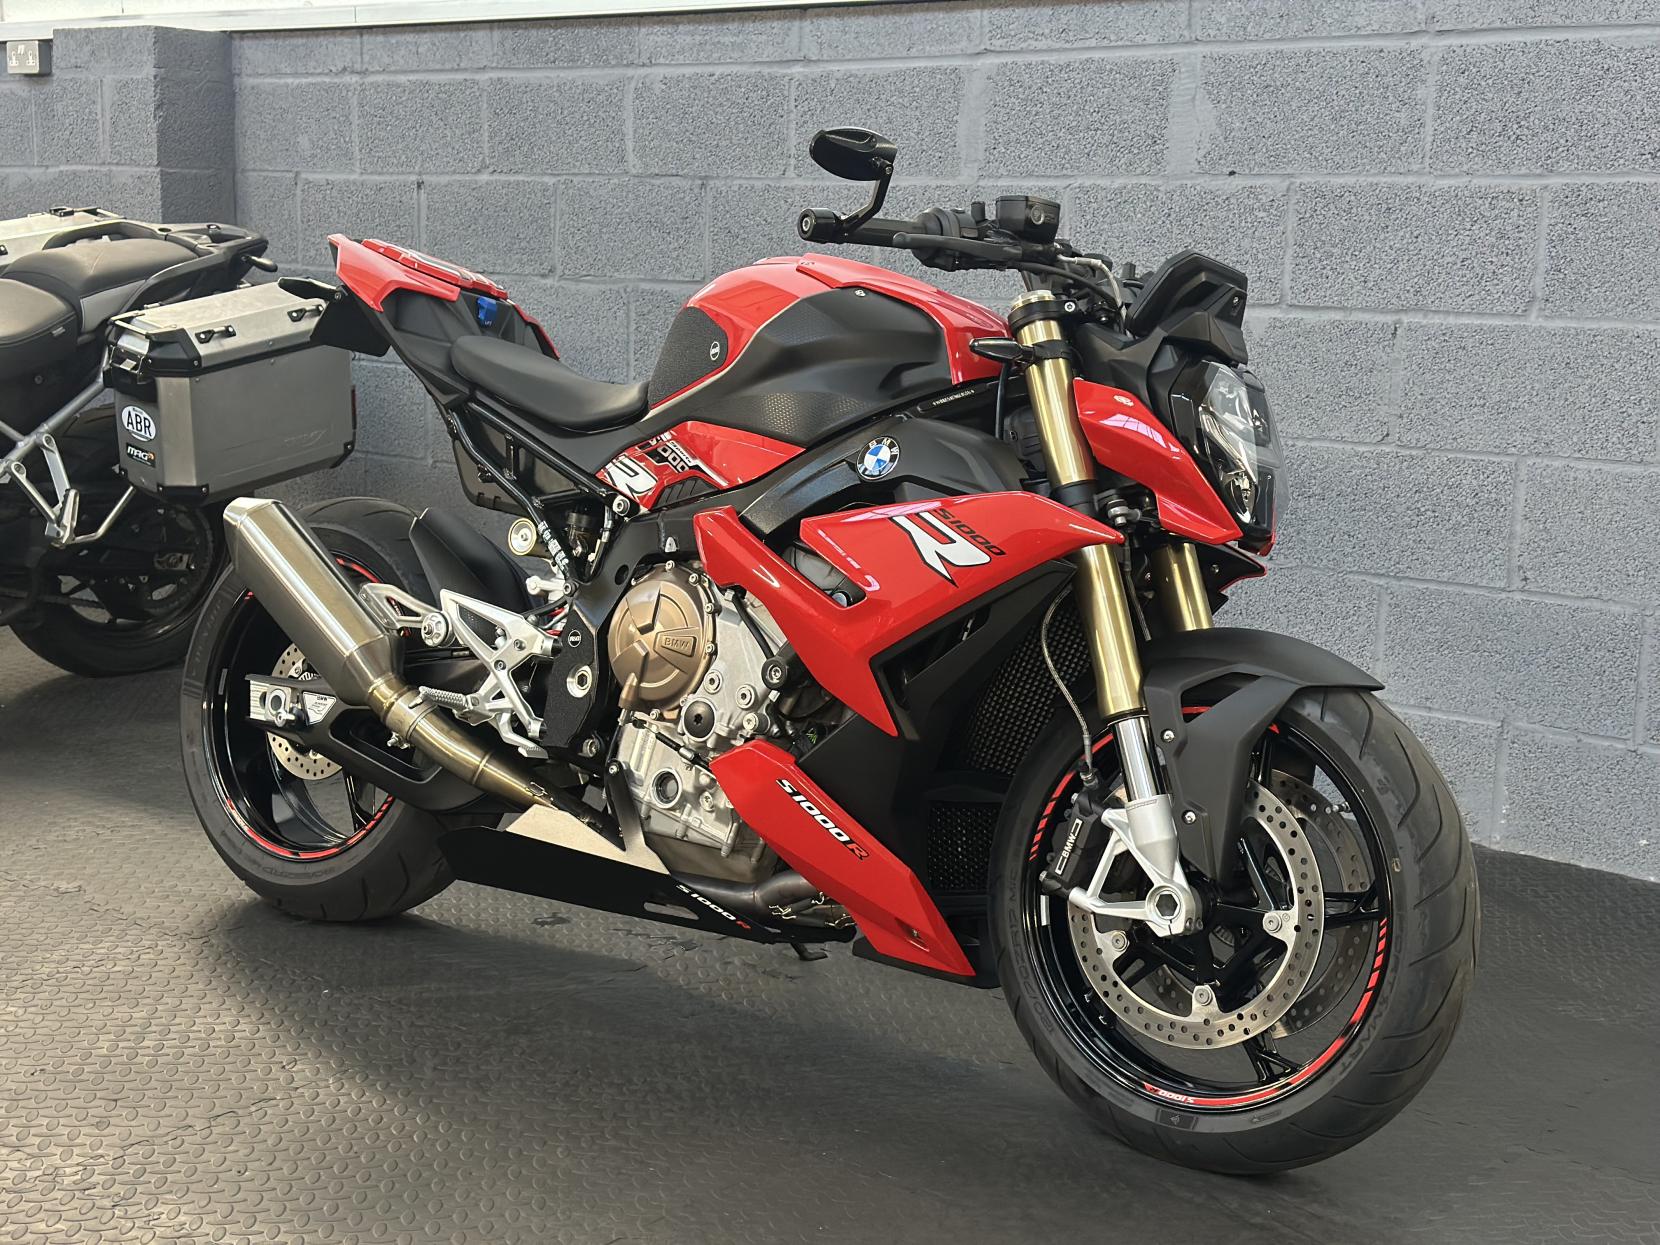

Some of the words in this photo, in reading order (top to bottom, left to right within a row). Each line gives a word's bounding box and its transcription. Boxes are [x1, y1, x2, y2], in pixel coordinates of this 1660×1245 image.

[126, 410, 152, 437] ABR
[868, 437, 900, 455] BMW
[888, 509, 992, 589] R
[936, 508, 1006, 556] S1000
[664, 637, 690, 649] BMW
[776, 779, 870, 860] S1000R
[1061, 833, 1077, 858] BMW
[675, 884, 752, 930] S1000R
